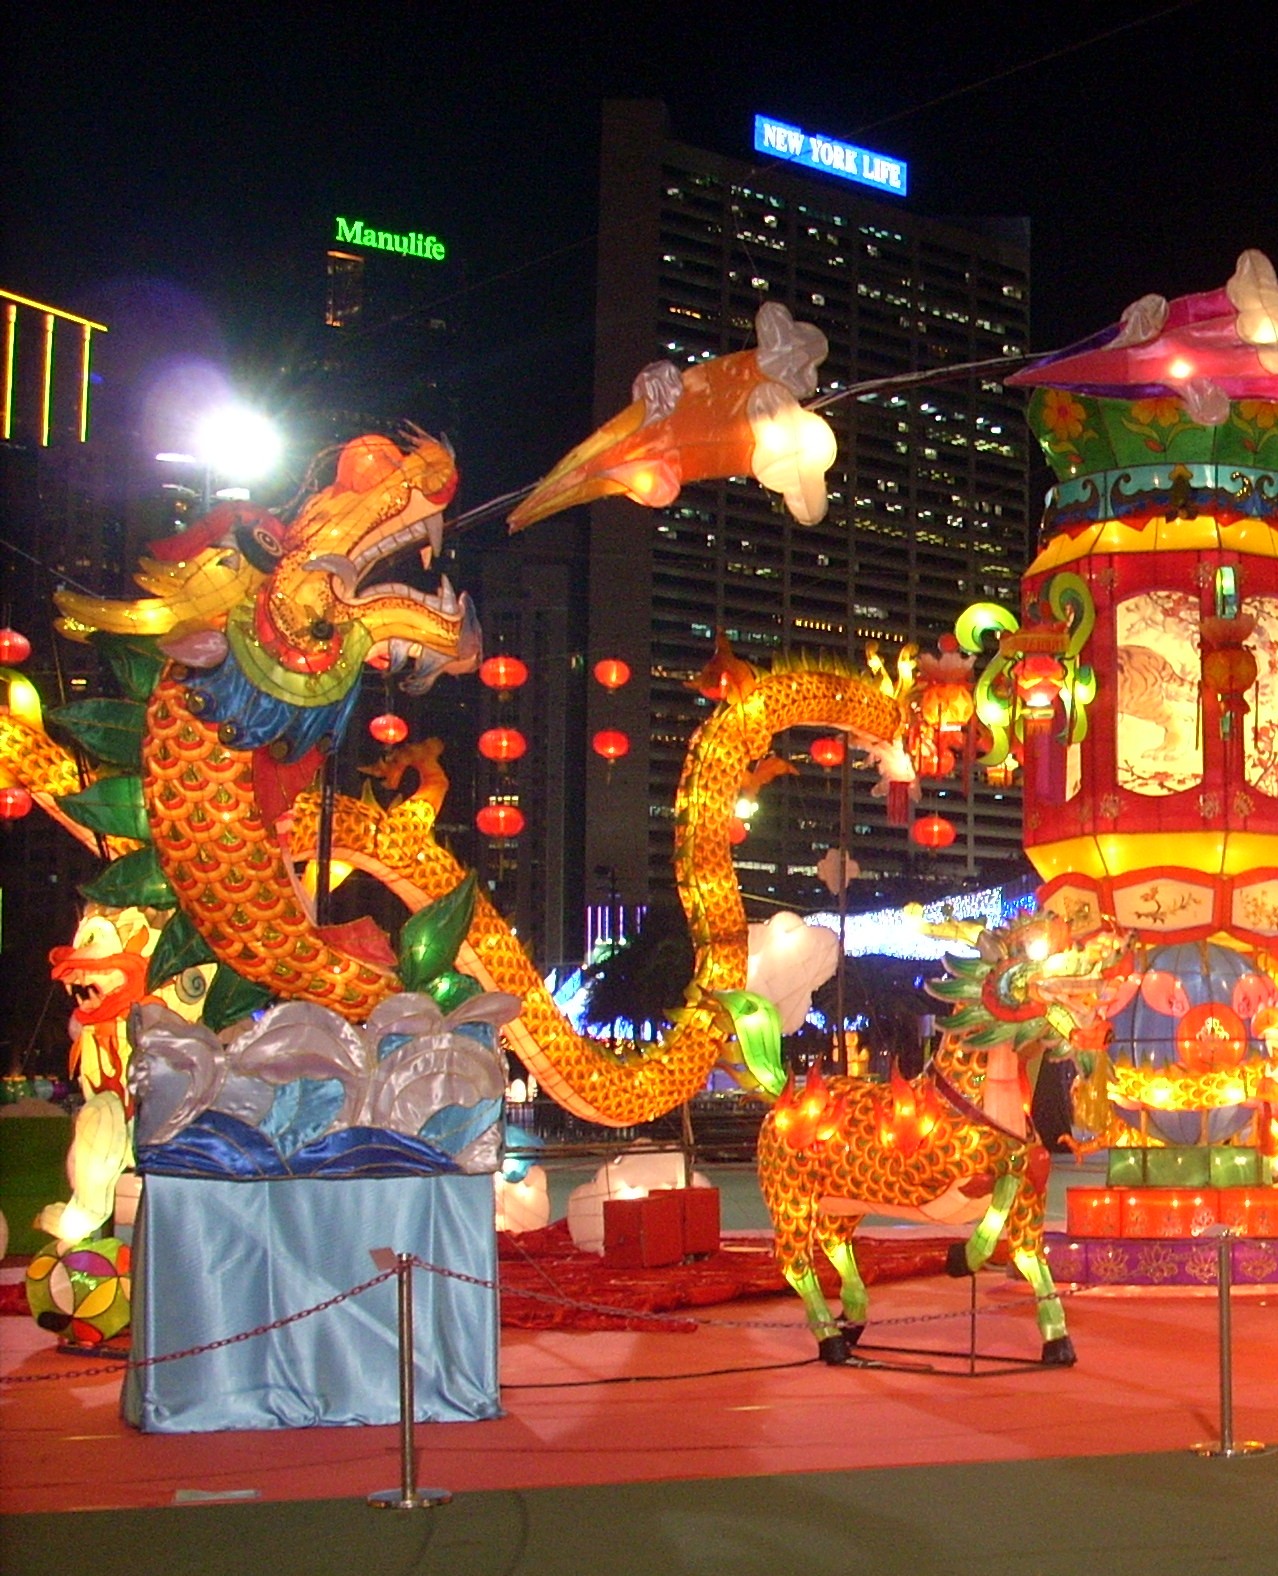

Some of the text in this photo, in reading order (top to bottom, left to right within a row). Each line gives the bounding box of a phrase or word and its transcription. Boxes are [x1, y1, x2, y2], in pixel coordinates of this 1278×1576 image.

[763, 123, 901, 189] NEW YORK LIFE
[335, 216, 446, 261] Manulife
